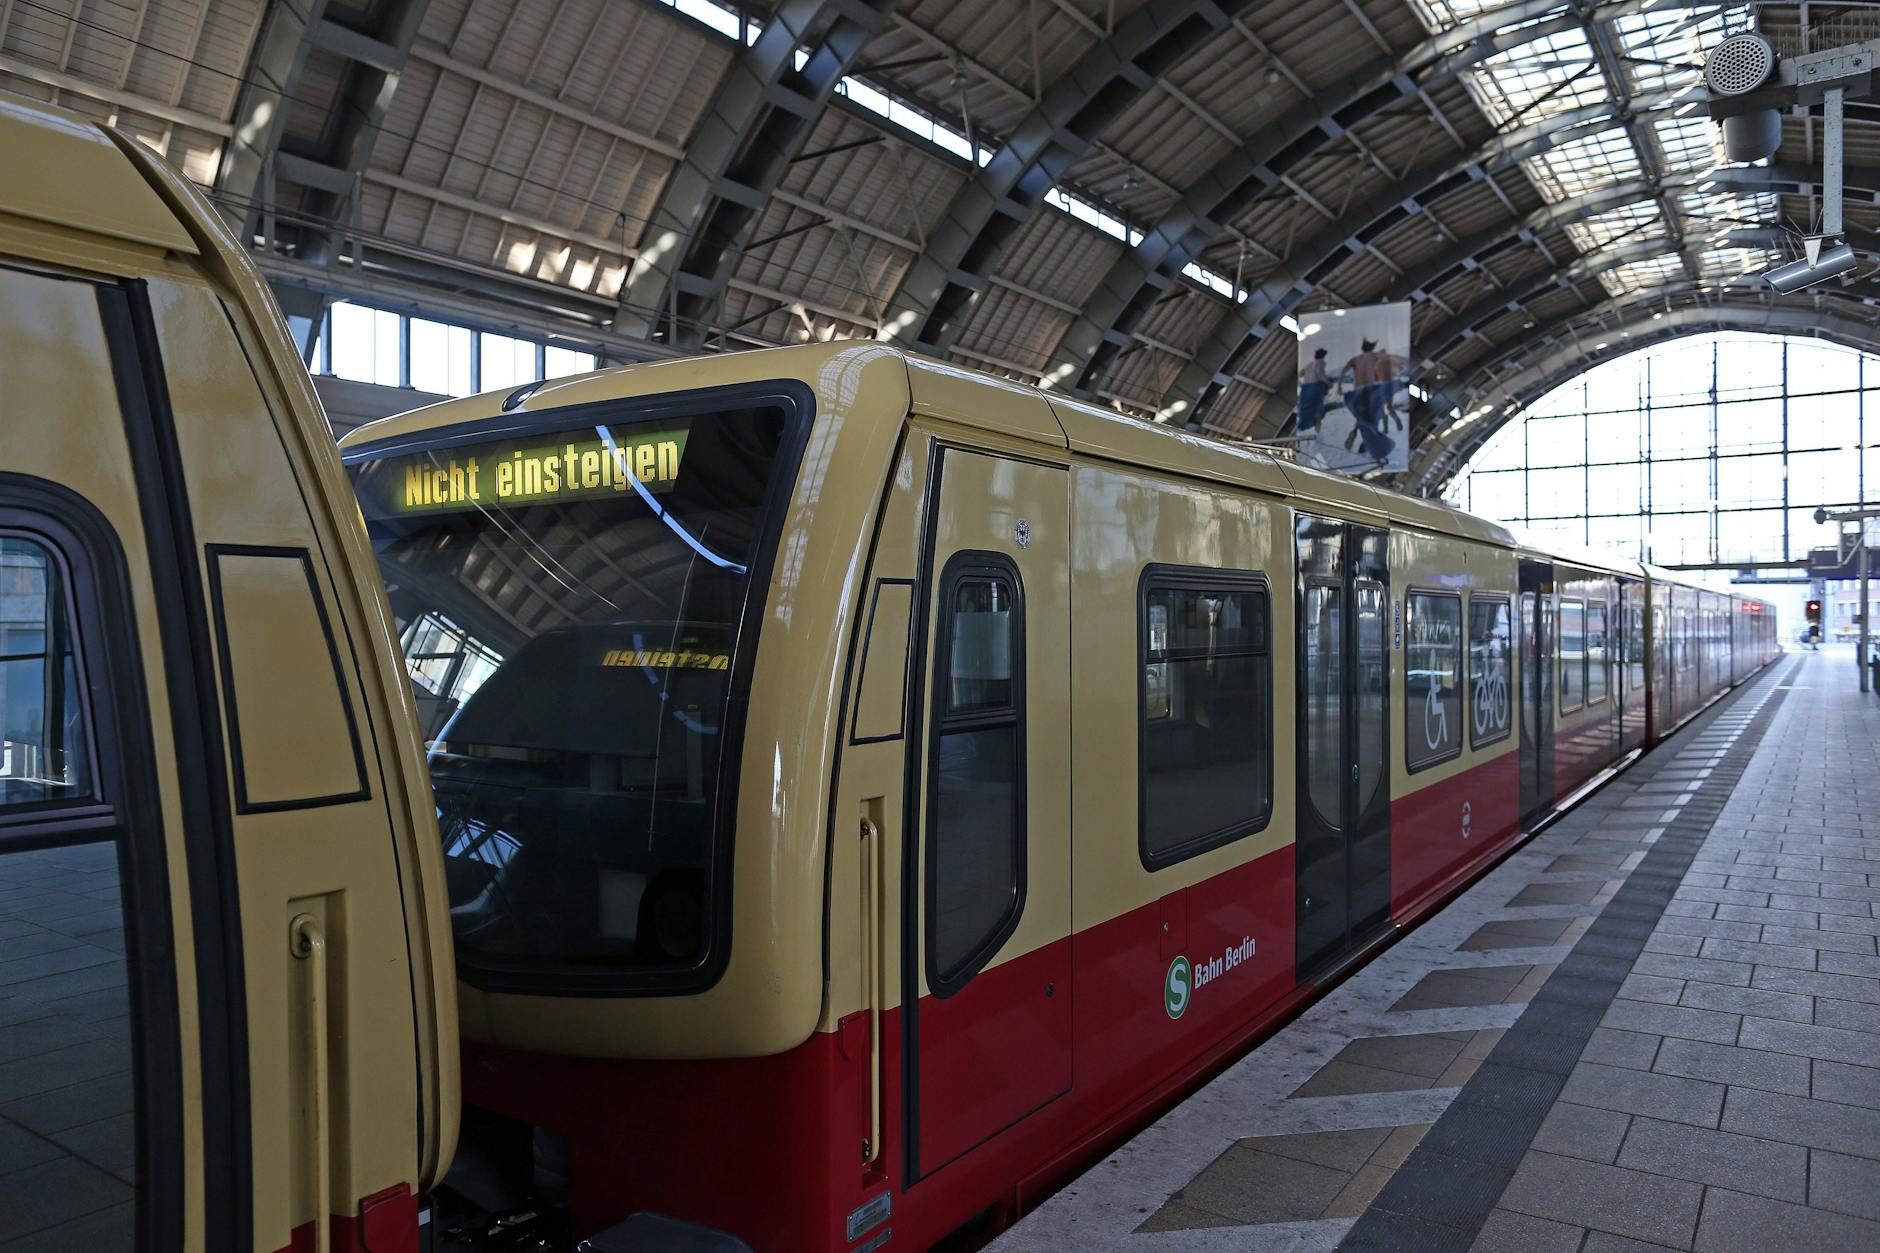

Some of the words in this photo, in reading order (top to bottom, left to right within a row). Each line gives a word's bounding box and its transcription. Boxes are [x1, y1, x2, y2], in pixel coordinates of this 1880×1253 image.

[405, 459, 480, 507] Nicht
[496, 439, 679, 497] einsteigen
[1170, 963, 1187, 1012] S
[1194, 956, 1223, 990] Bahn
[1225, 935, 1256, 972] Berlin
